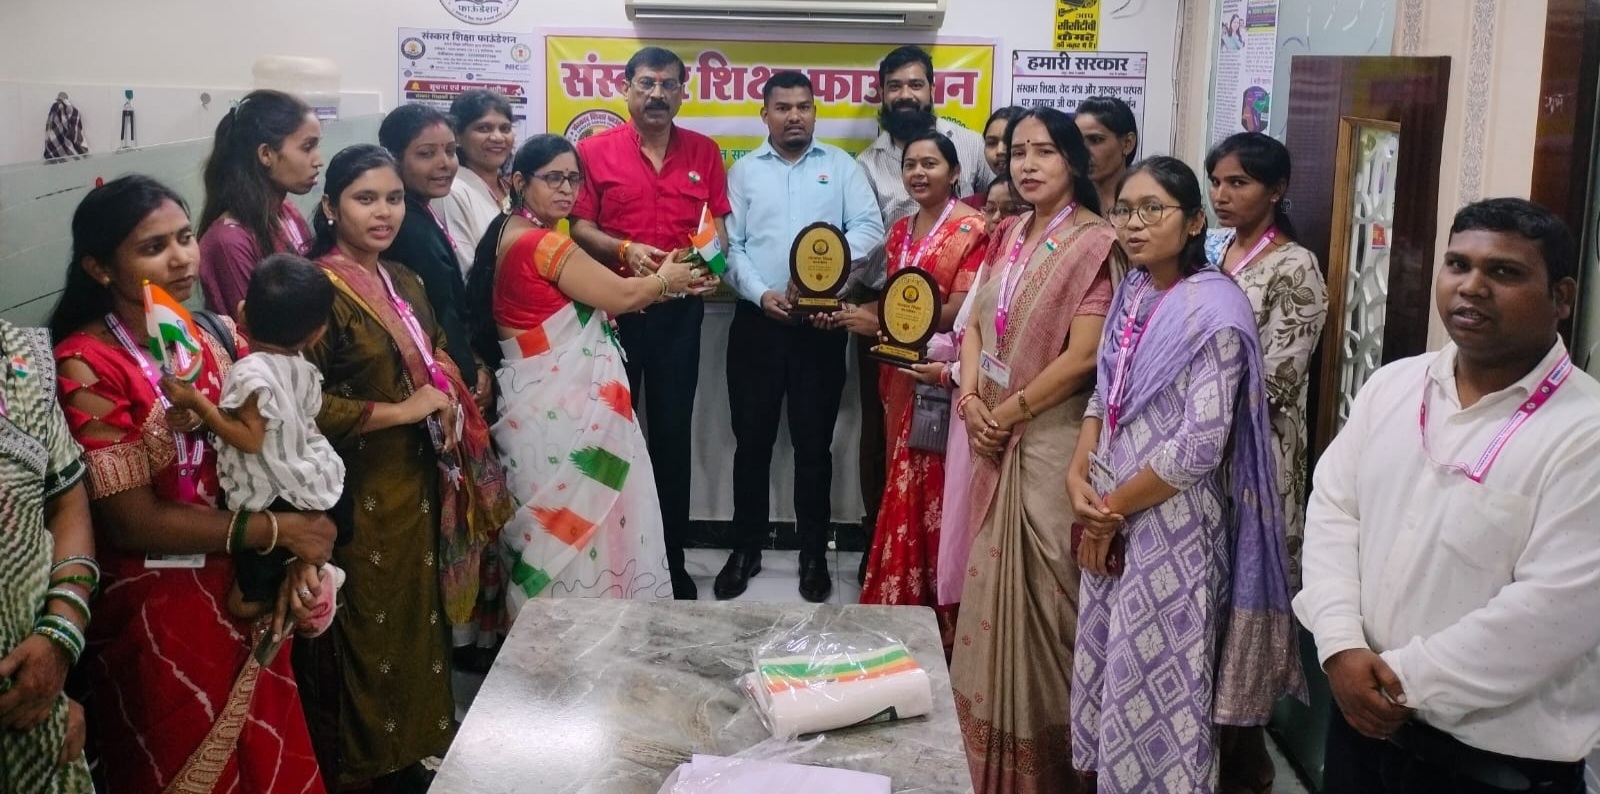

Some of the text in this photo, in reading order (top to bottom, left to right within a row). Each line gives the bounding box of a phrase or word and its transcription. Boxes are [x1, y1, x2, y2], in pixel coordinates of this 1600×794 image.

[422, 32, 450, 41] संस्कार
[452, 31, 474, 42] शिक्षा
[1028, 52, 1071, 70] हमारी
[1075, 58, 1129, 71] सरकार
[1017, 82, 1037, 94] संस्कार
[1040, 81, 1057, 94] शिक्षा,
[1060, 82, 1069, 93] वेद
[1072, 84, 1082, 94] मंत्र
[1084, 83, 1096, 94] और
[1057, 96, 1064, 107] जी
[1066, 99, 1076, 108] का
